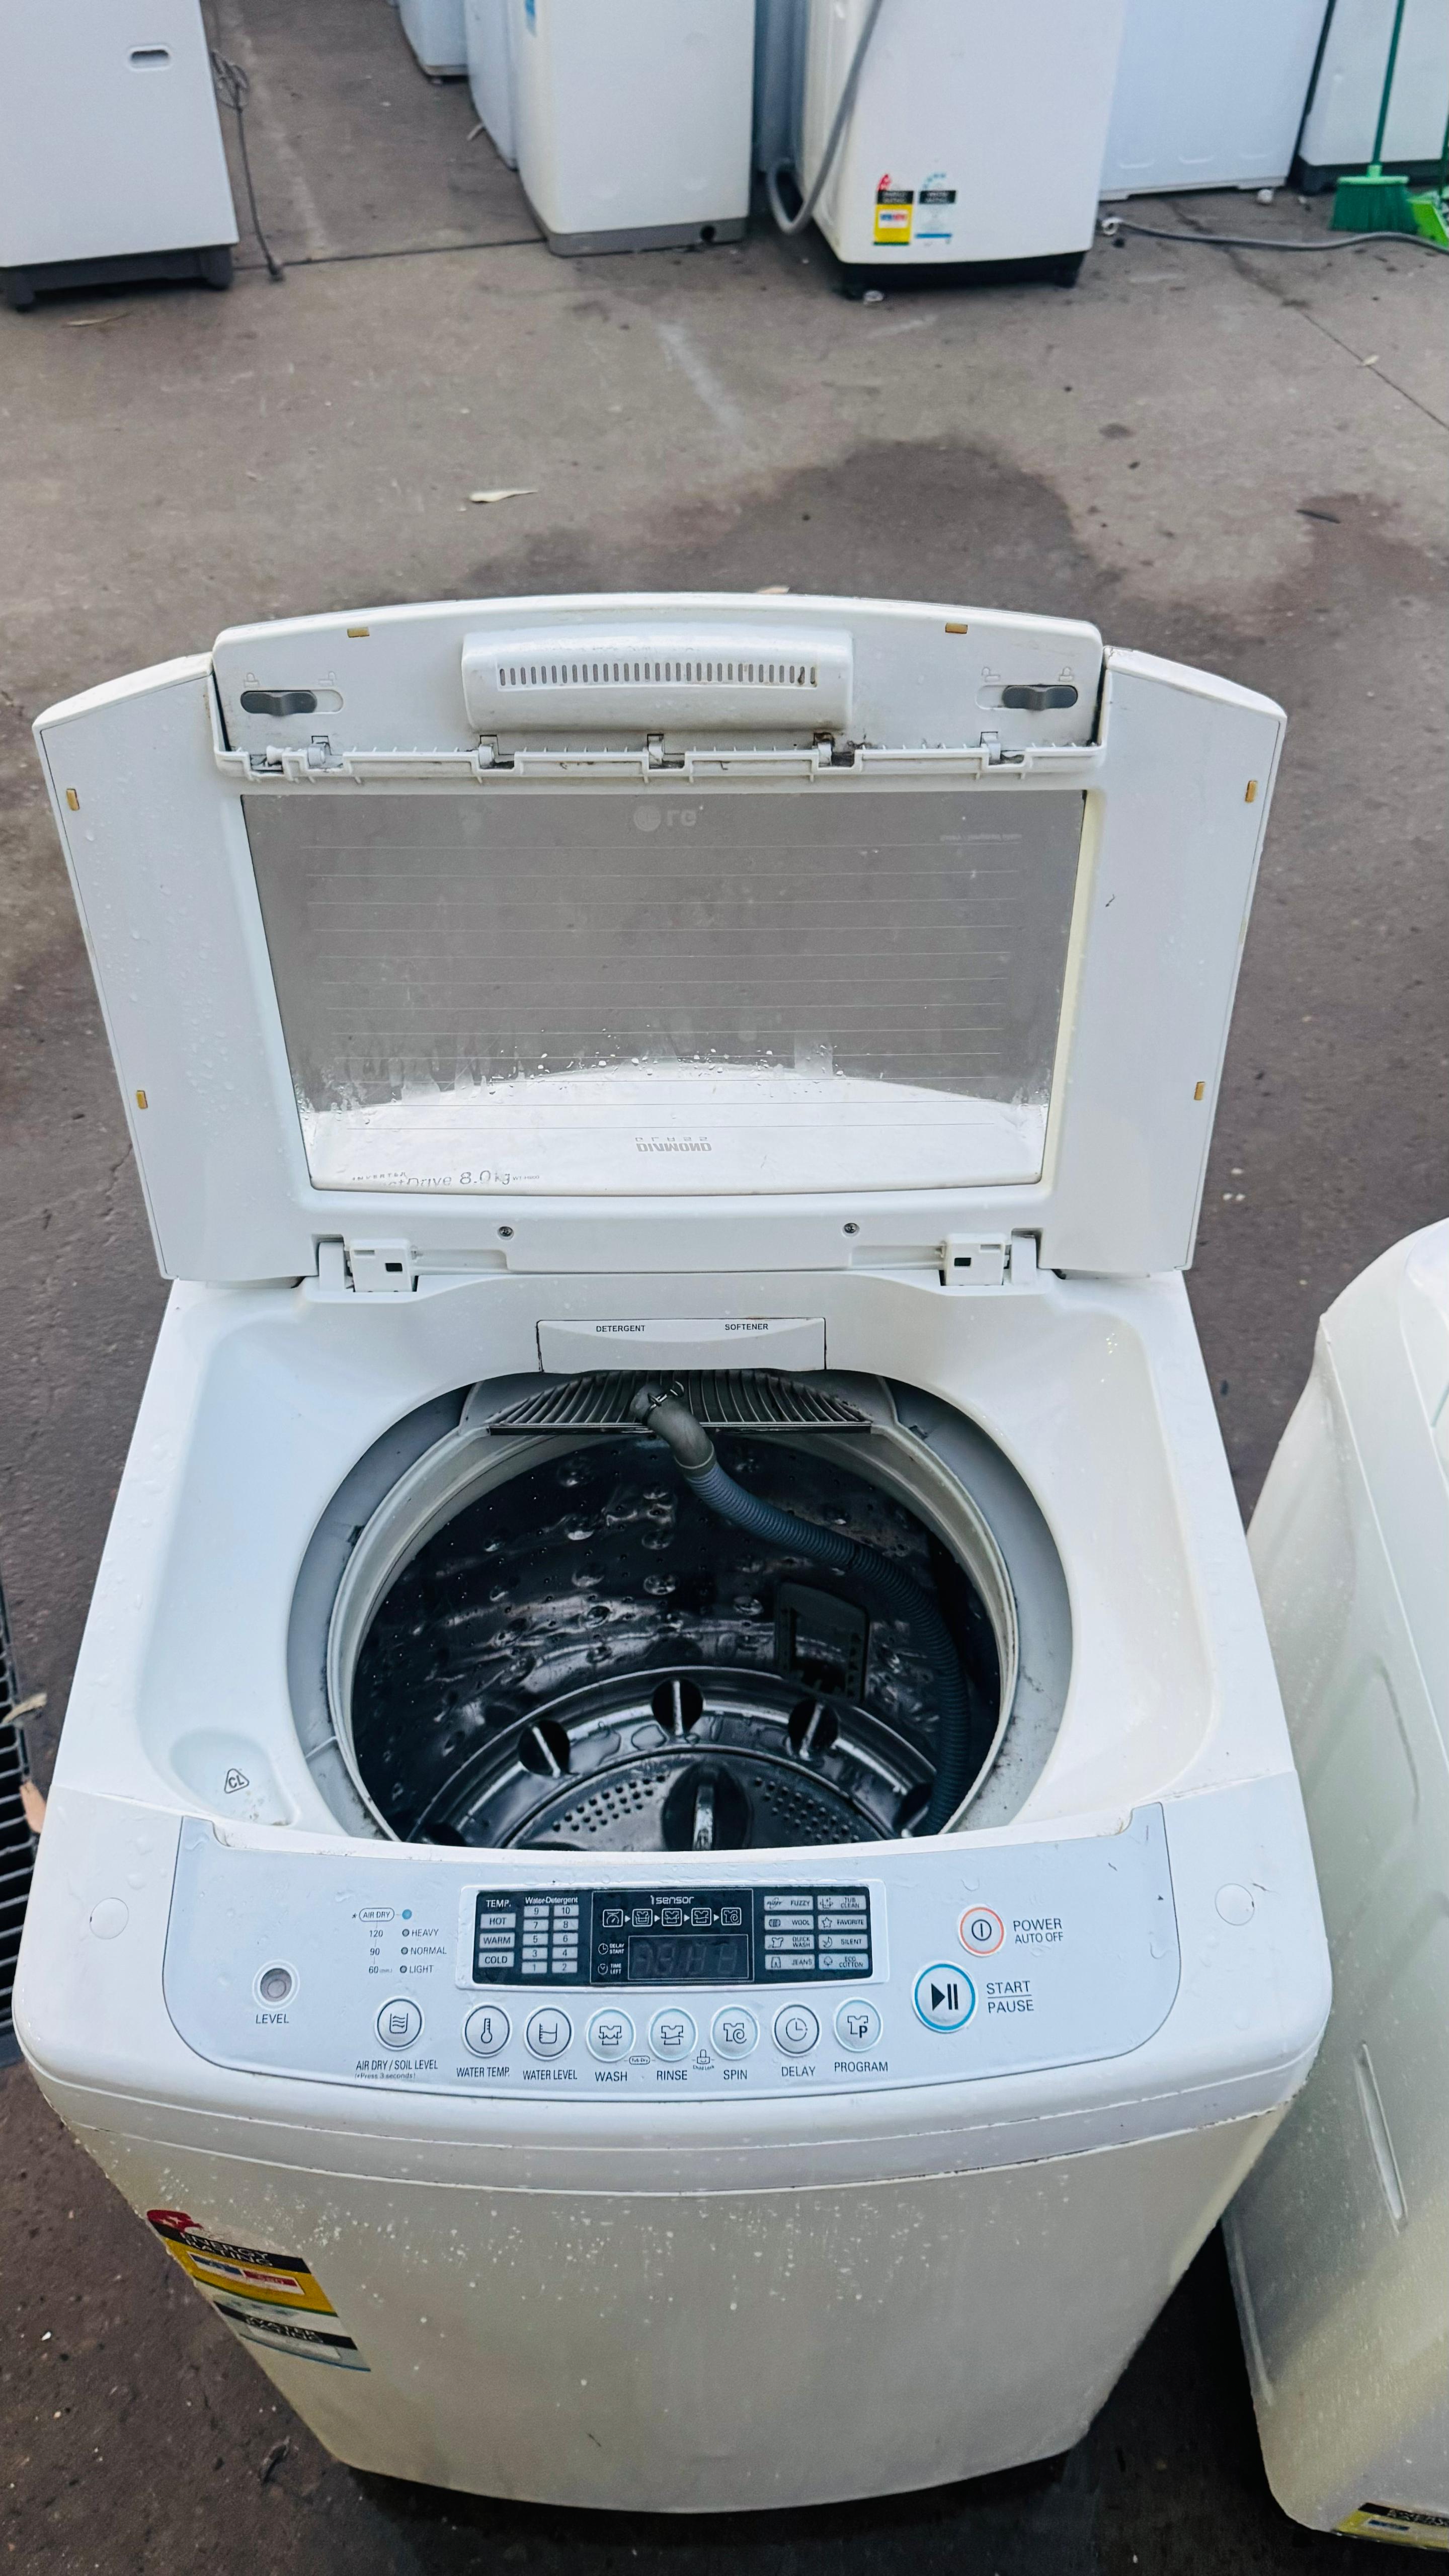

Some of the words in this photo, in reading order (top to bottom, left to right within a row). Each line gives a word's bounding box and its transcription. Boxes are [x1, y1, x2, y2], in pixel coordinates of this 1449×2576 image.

[228, 1775, 245, 1788] CL
[486, 1899, 512, 1908] TEMP.
[562, 1906, 571, 1914] 10
[489, 1917, 507, 1925] HOT
[1013, 1917, 1063, 1931] POWER
[369, 1929, 383, 1938] 120
[411, 1928, 439, 1937] HEAVY
[1014, 1933, 1043, 1944] AUTO
[1045, 1931, 1064, 1942] OFF
[483, 1937, 511, 1945] WARM
[370, 1948, 380, 1956] 90
[410, 1947, 447, 1955] NORMAL
[485, 1956, 508, 1964] COLD
[368, 1966, 379, 1974] 60
[409, 1964, 434, 1973] LIGHT
[562, 1963, 567, 1971] 2
[986, 1980, 1031, 1995] START
[988, 1999, 1034, 2014] PAUSE
[256, 2014, 289, 2024] LEVEL
[355, 2060, 369, 2070] AIR
[371, 2059, 388, 2070] DRY
[394, 2060, 413, 2070] SOIL
[415, 2059, 438, 2069] LEVEL
[834, 2061, 889, 2072] PROGRAM
[456, 2067, 485, 2077] WATER
[522, 2070, 551, 2080] WATER
[553, 2069, 578, 2080] LEVEL
[595, 2071, 628, 2081] WASH
[656, 2070, 688, 2080] RINSE
[723, 2069, 748, 2080] SPIN
[781, 2066, 816, 2077] DELAY
